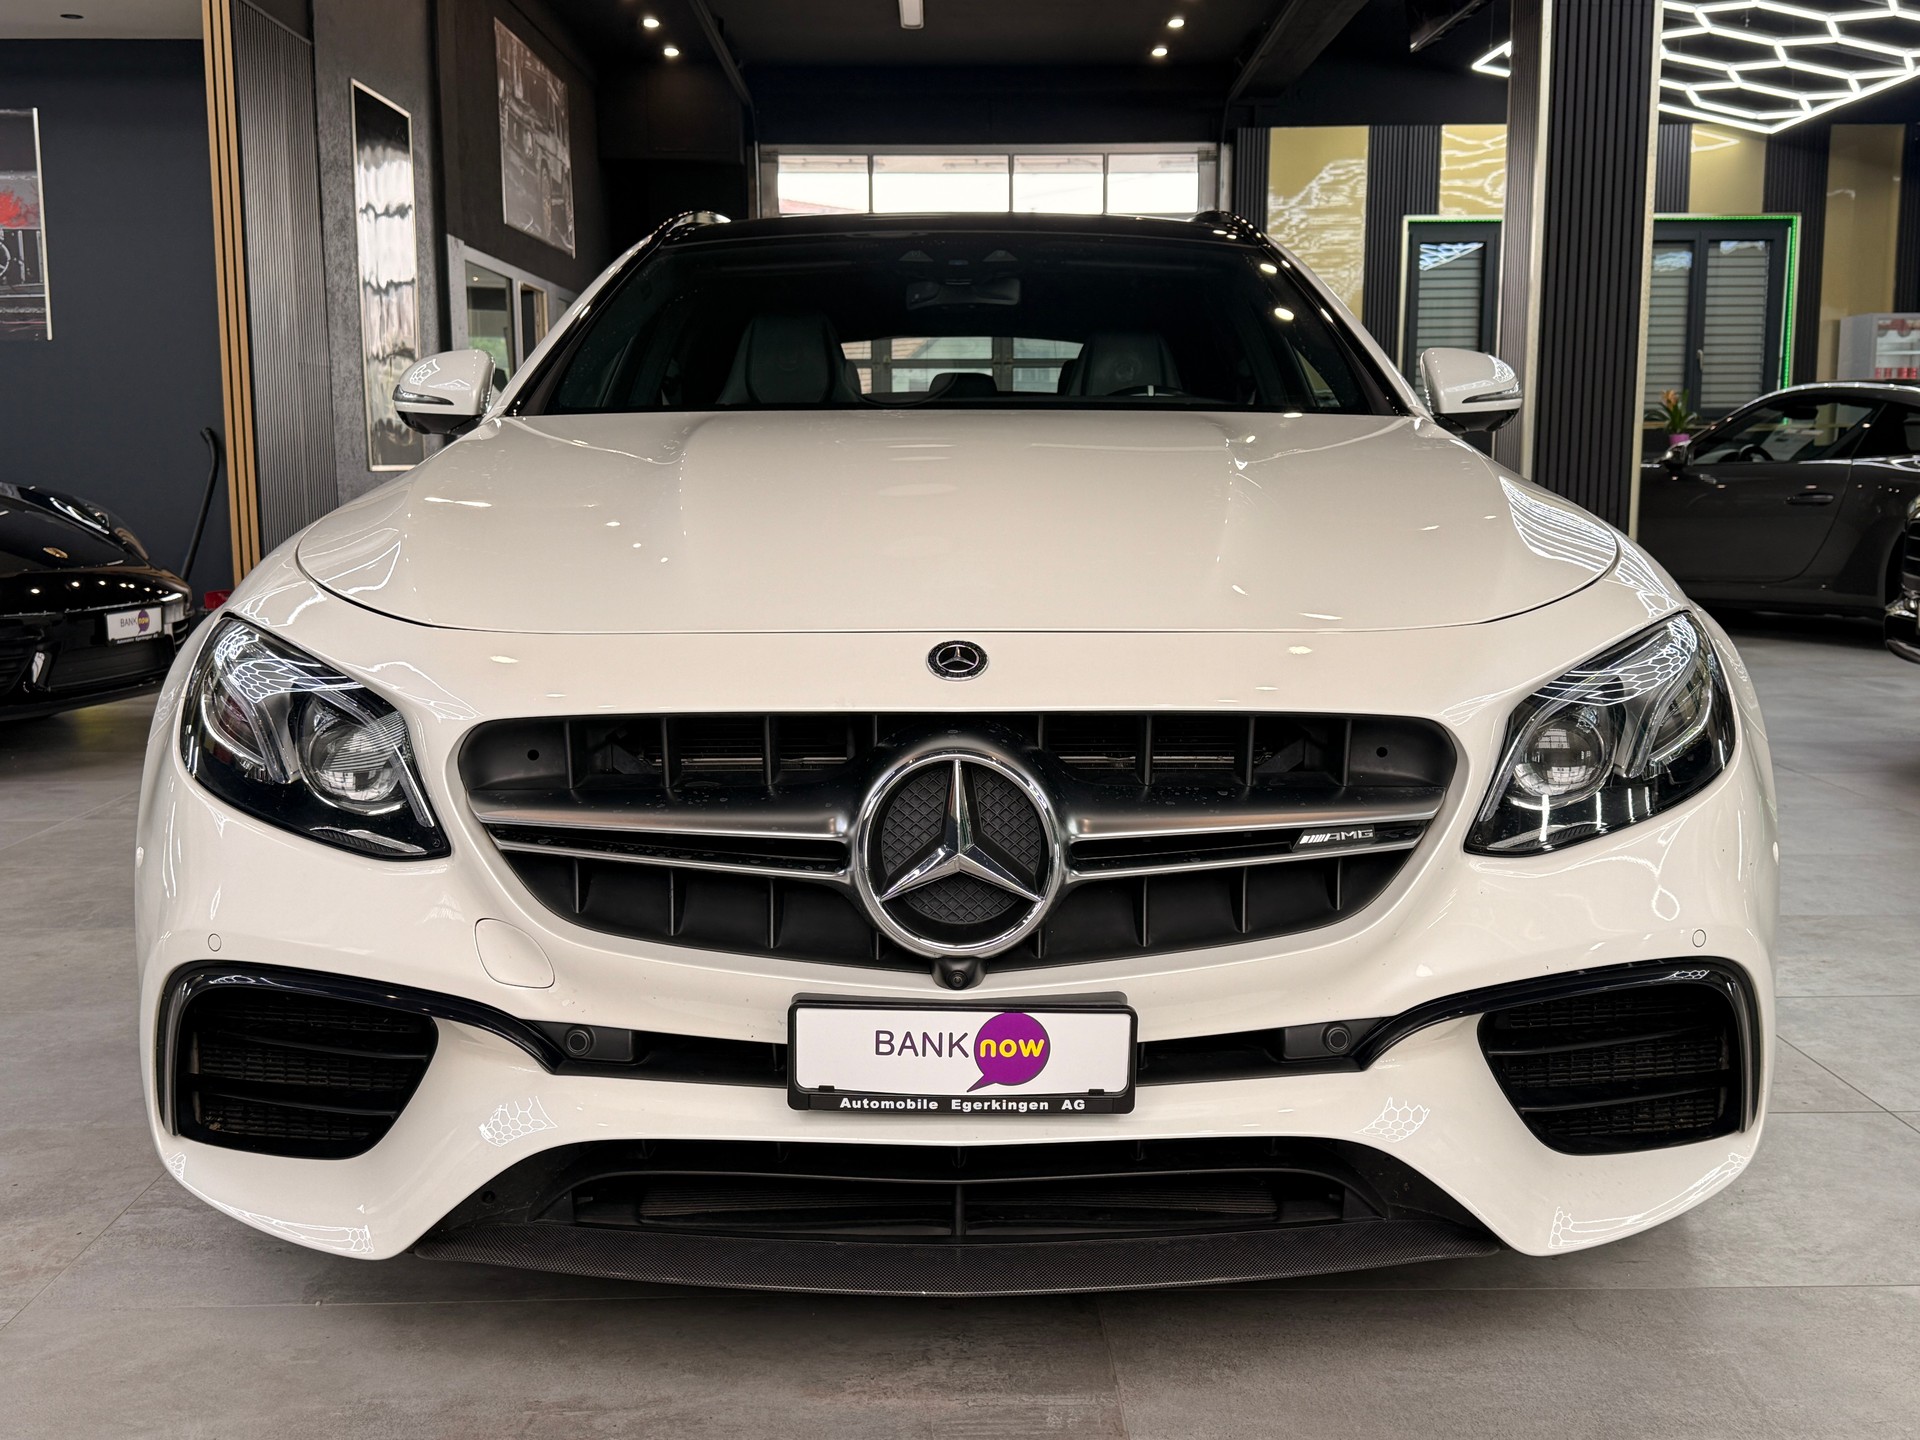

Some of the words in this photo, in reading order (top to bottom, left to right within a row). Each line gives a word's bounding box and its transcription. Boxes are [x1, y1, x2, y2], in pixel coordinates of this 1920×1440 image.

[120, 618, 137, 628] BANK
[875, 1030, 969, 1058] BANK
[979, 1038, 1045, 1058] now
[840, 1098, 939, 1110] Automobile
[951, 1099, 1049, 1113] Egerkingen
[1061, 1100, 1086, 1111] AG
